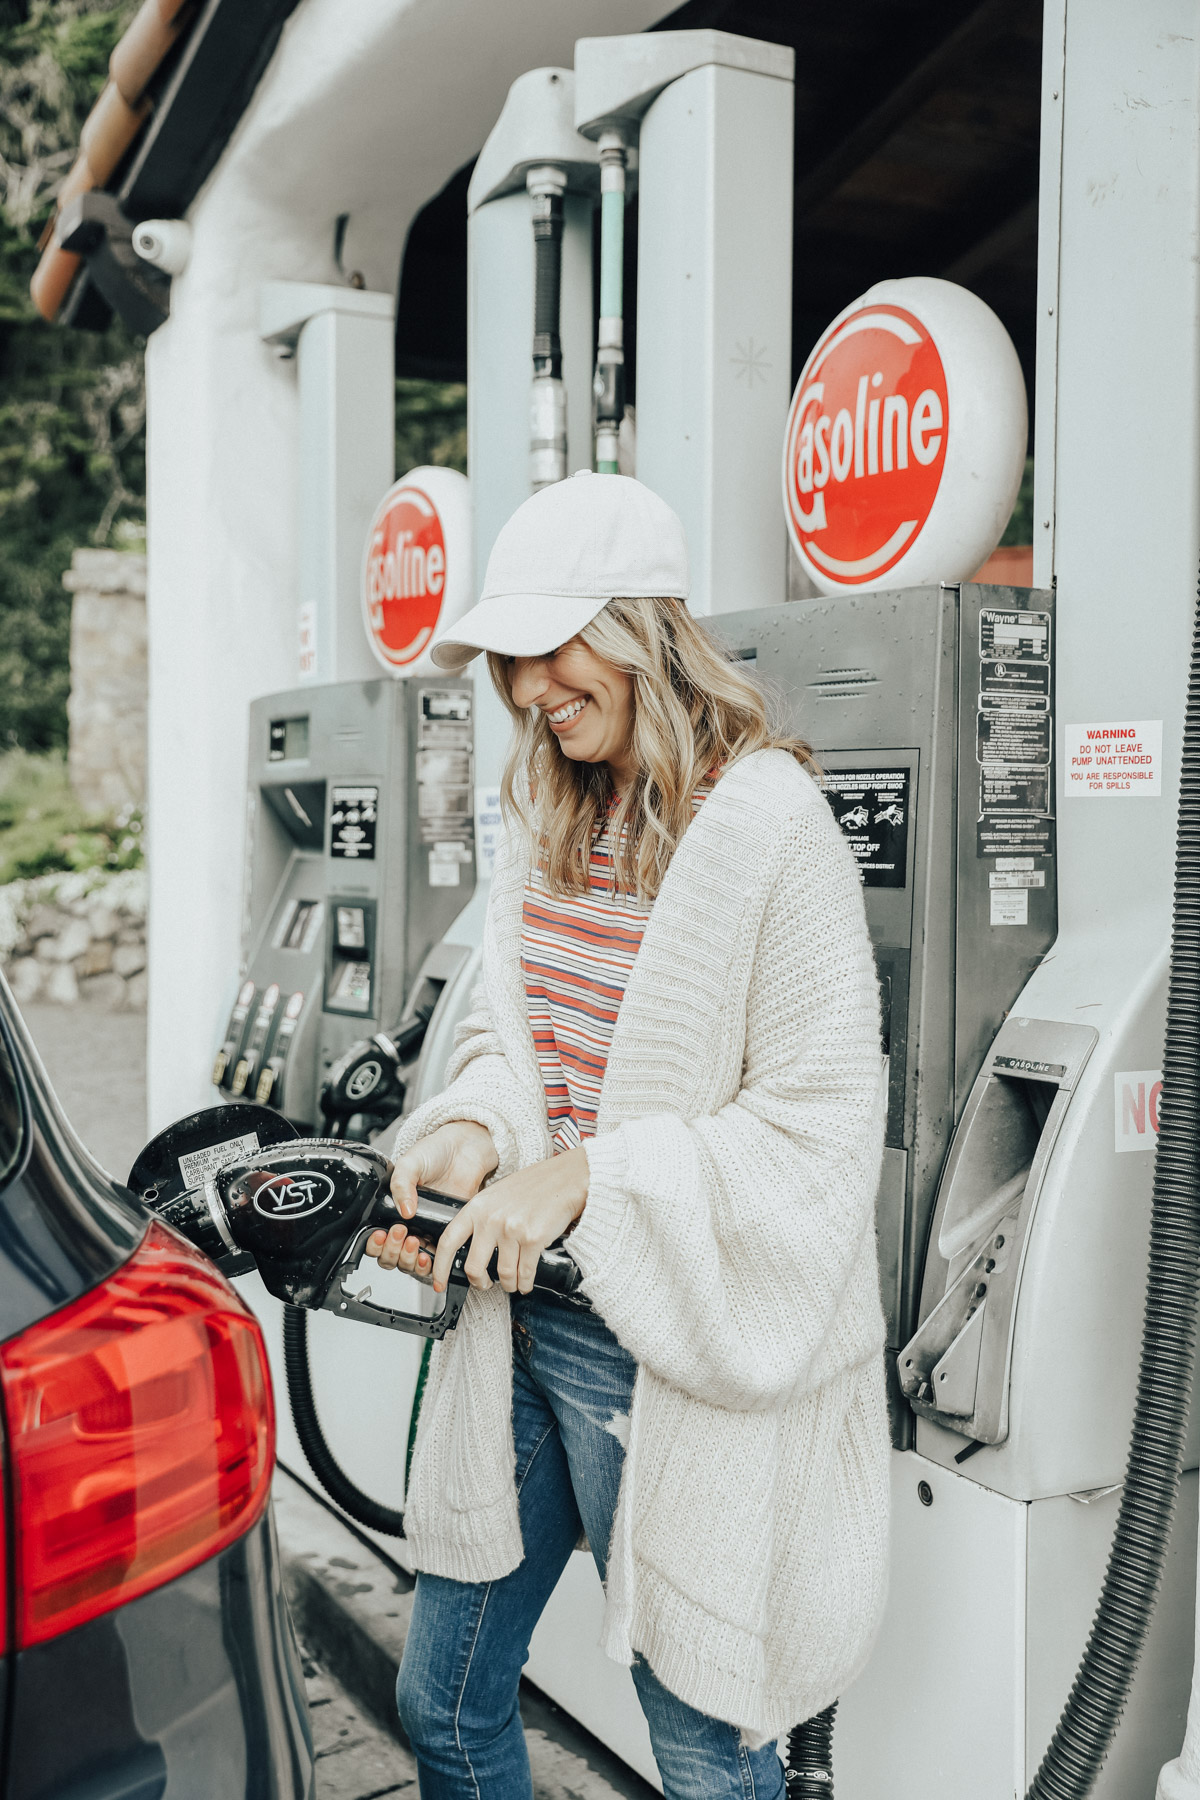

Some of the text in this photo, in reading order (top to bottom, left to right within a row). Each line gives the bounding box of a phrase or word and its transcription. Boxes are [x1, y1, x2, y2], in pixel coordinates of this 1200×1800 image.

[788, 371, 943, 533] Gasoline
[1087, 729, 1136, 740] WARNING
[1080, 743, 1143, 754] DO NOT LEAVE
[1072, 755, 1152, 766] PUMP UNATTENDED
[875, 772, 905, 780] OPERATION
[1086, 772, 1100, 780] ARE
[1103, 771, 1154, 780] RESPONSIBLE
[1106, 781, 1131, 789] SPILLS
[853, 843, 866, 852] TOP
[866, 843, 880, 852] OFF
[182, 1150, 211, 1165] UNLEADED
[213, 1146, 227, 1155] FUEL
[229, 1139, 244, 1149] ONLY
[184, 1158, 209, 1171] PREMIUM
[185, 1161, 218, 1178] CARBURANT
[188, 1173, 206, 1186] SUPER
[267, 1179, 318, 1212] VST
